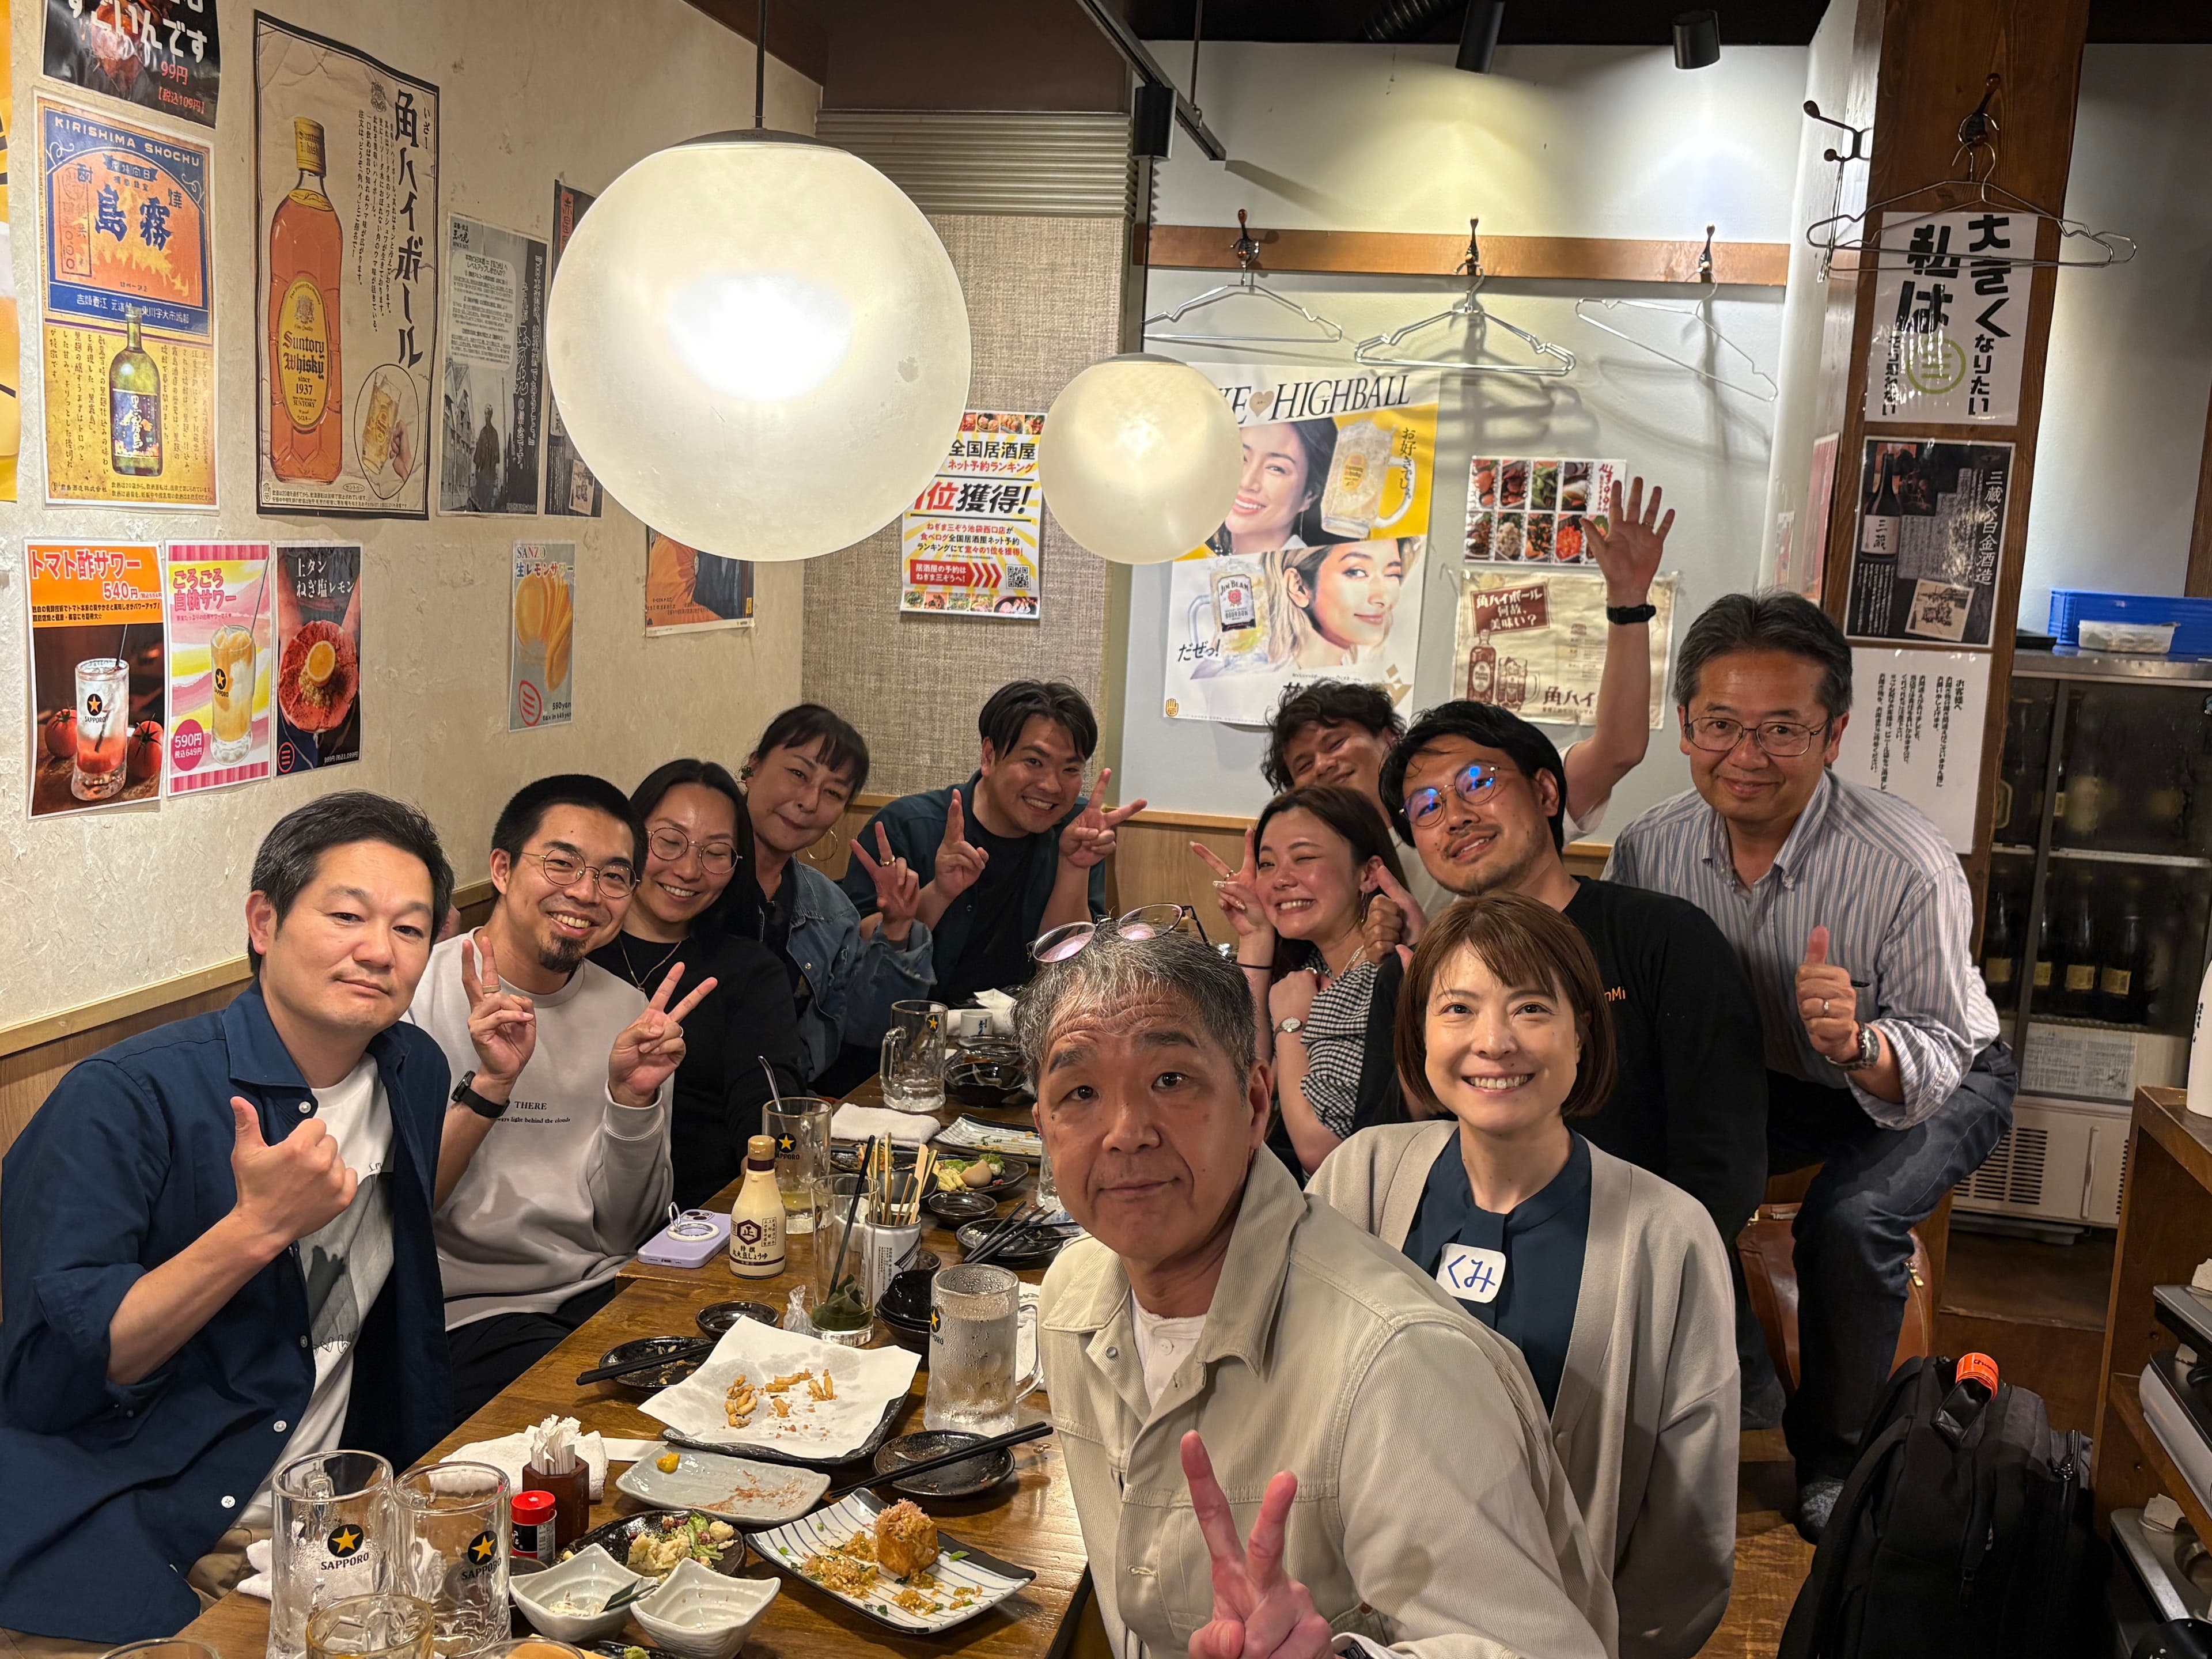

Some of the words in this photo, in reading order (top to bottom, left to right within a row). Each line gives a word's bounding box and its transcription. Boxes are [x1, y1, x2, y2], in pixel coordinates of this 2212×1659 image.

[161, 60, 188, 86] 99円
[55, 116, 137, 149] KIRISHIMA
[145, 142, 200, 167] SHOCHU
[395, 89, 423, 369] 角ハイボール
[1895, 224, 1961, 334] 私は
[1968, 214, 2011, 415] 大きくなりたい
[283, 331, 324, 359] Suntory
[283, 353, 324, 380] Whisky
[296, 383, 313, 395] 1937
[1268, 374, 1411, 421] HIGHBALL
[948, 440, 1036, 460] 全国居酒屋
[948, 459, 1035, 474] ネット予約ランキング
[926, 522, 1014, 535] ねぎま三ぞう池袋西口店が
[921, 533, 1020, 546] 食べログ全国居酒屋ネット予約
[517, 546, 546, 559] SANZO
[31, 549, 142, 580] トマト酢サワー
[296, 557, 327, 577] 上タン
[516, 561, 573, 577] 生レモンサワー
[915, 563, 967, 574] 居酒屋の予約は
[173, 567, 224, 589] ごろごろ
[296, 578, 355, 599] ねぎ塩レモン
[1231, 579, 1249, 592] BEAM
[103, 581, 139, 601] 540円
[174, 589, 237, 611] 白桃サワー
[1476, 588, 1543, 609] 角ハイボール
[1543, 685, 1595, 707] 角ハイ
[175, 732, 202, 748] 590円
[175, 747, 202, 759] 税込649円
[514, 1101, 547, 1110] THERE
[1447, 1254, 1496, 1293] くみ
[320, 1552, 369, 1570] SAPPORO
[461, 1557, 502, 1581] SAPPORO
